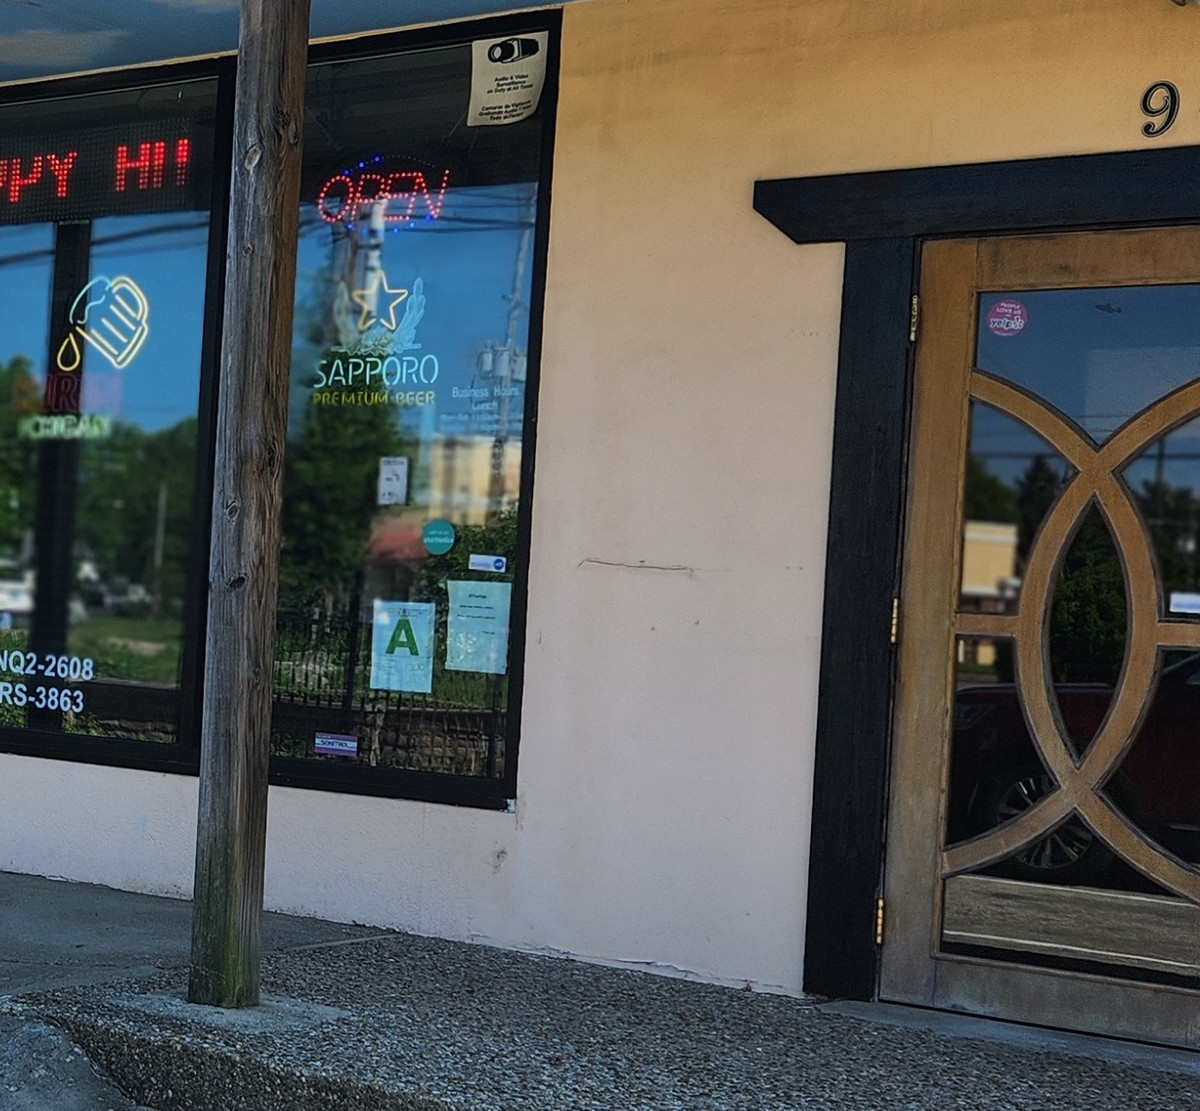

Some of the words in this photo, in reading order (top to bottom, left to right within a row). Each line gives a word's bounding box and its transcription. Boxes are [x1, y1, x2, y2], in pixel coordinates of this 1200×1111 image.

[1140, 79, 1180, 138] 9
[317, 169, 450, 223] OPEN
[989, 317, 1013, 330] yelp
[313, 354, 439, 388] SAPPORO
[313, 390, 389, 406] PREMIUM
[395, 390, 436, 406] BEER
[451, 386, 489, 398] Business
[385, 618, 420, 657] A
